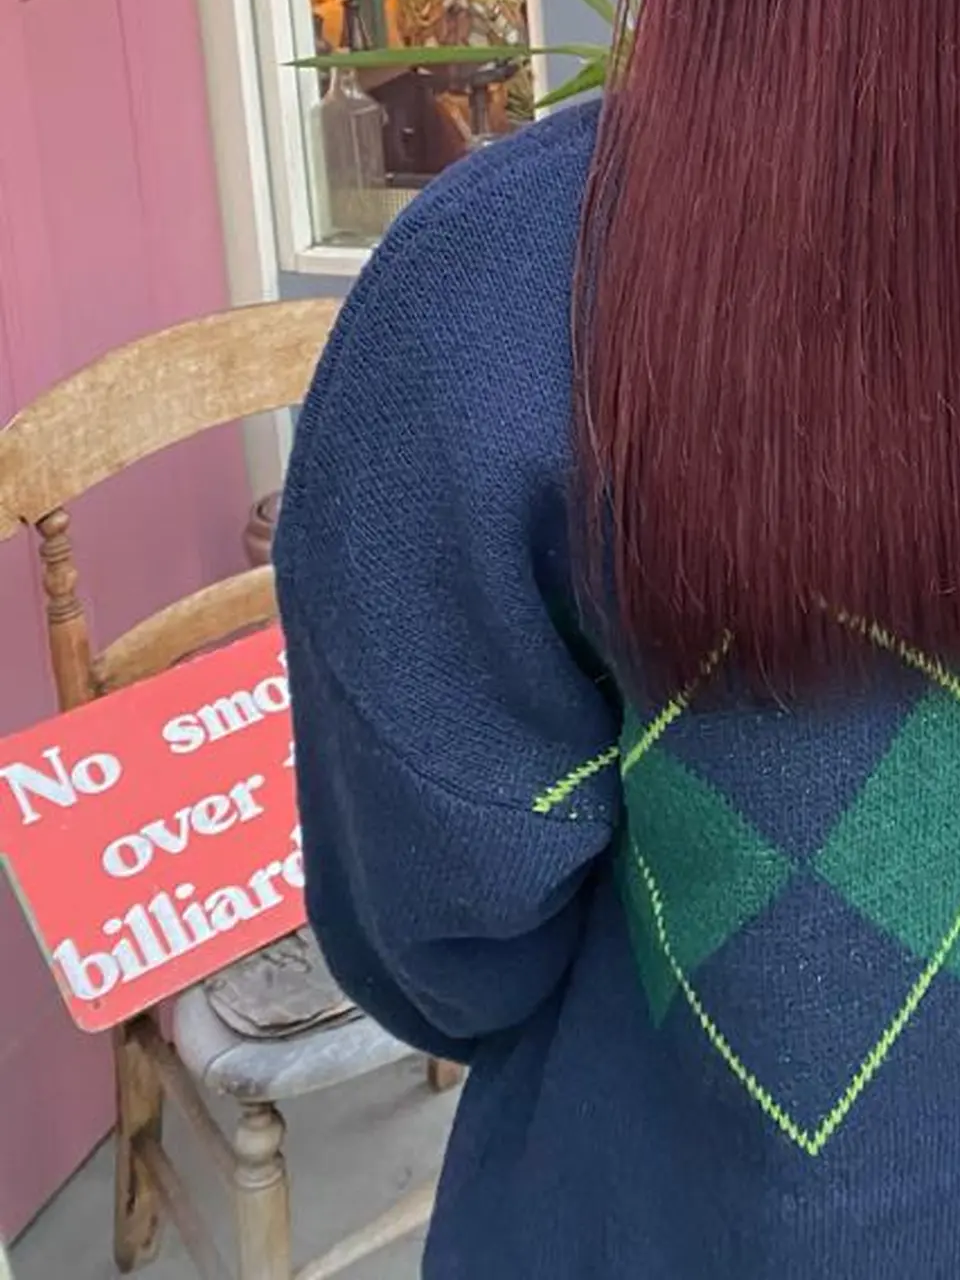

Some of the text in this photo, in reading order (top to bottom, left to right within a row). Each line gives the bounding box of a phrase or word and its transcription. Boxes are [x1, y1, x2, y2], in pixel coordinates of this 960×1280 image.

[0, 650, 291, 824] No smo
[102, 774, 265, 878] over
